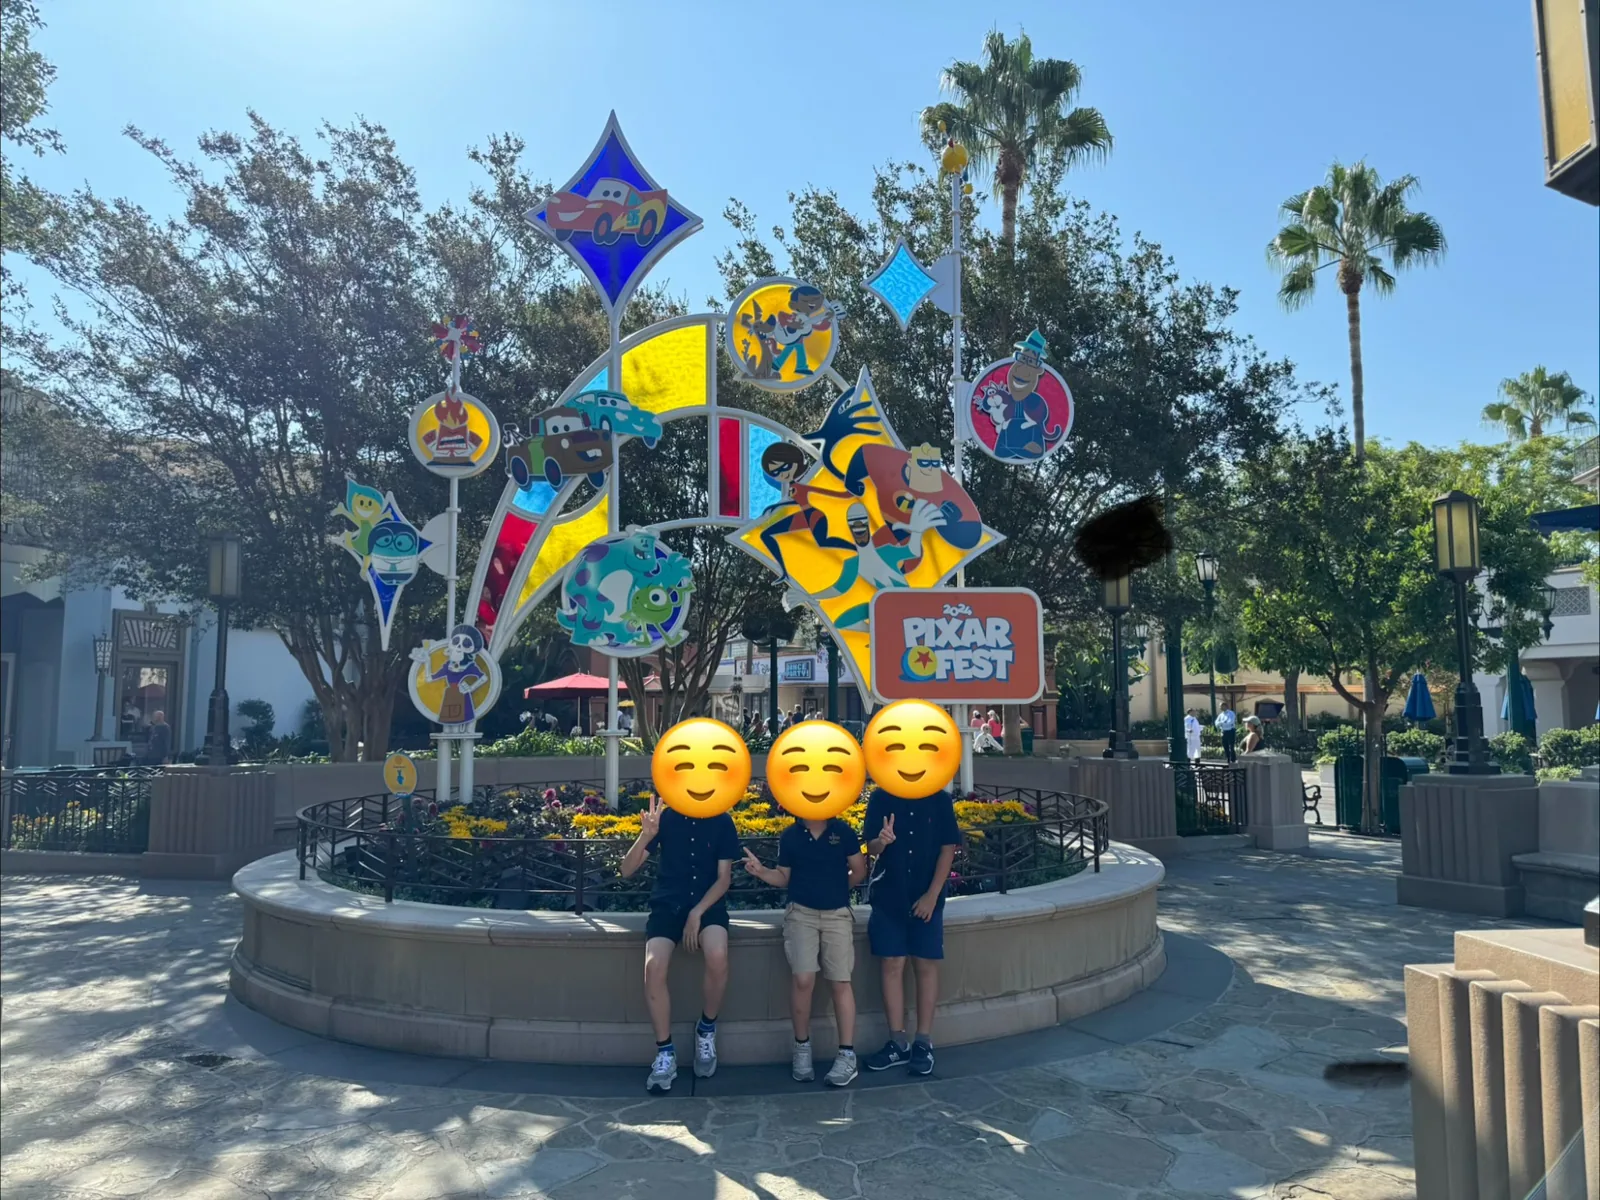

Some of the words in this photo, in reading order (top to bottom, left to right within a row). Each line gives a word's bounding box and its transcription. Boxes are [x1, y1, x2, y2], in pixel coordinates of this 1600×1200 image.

[626, 210, 641, 227] 95
[942, 603, 973, 617] 2024
[902, 616, 1014, 649] PIXAR
[935, 649, 1014, 682] FEST
